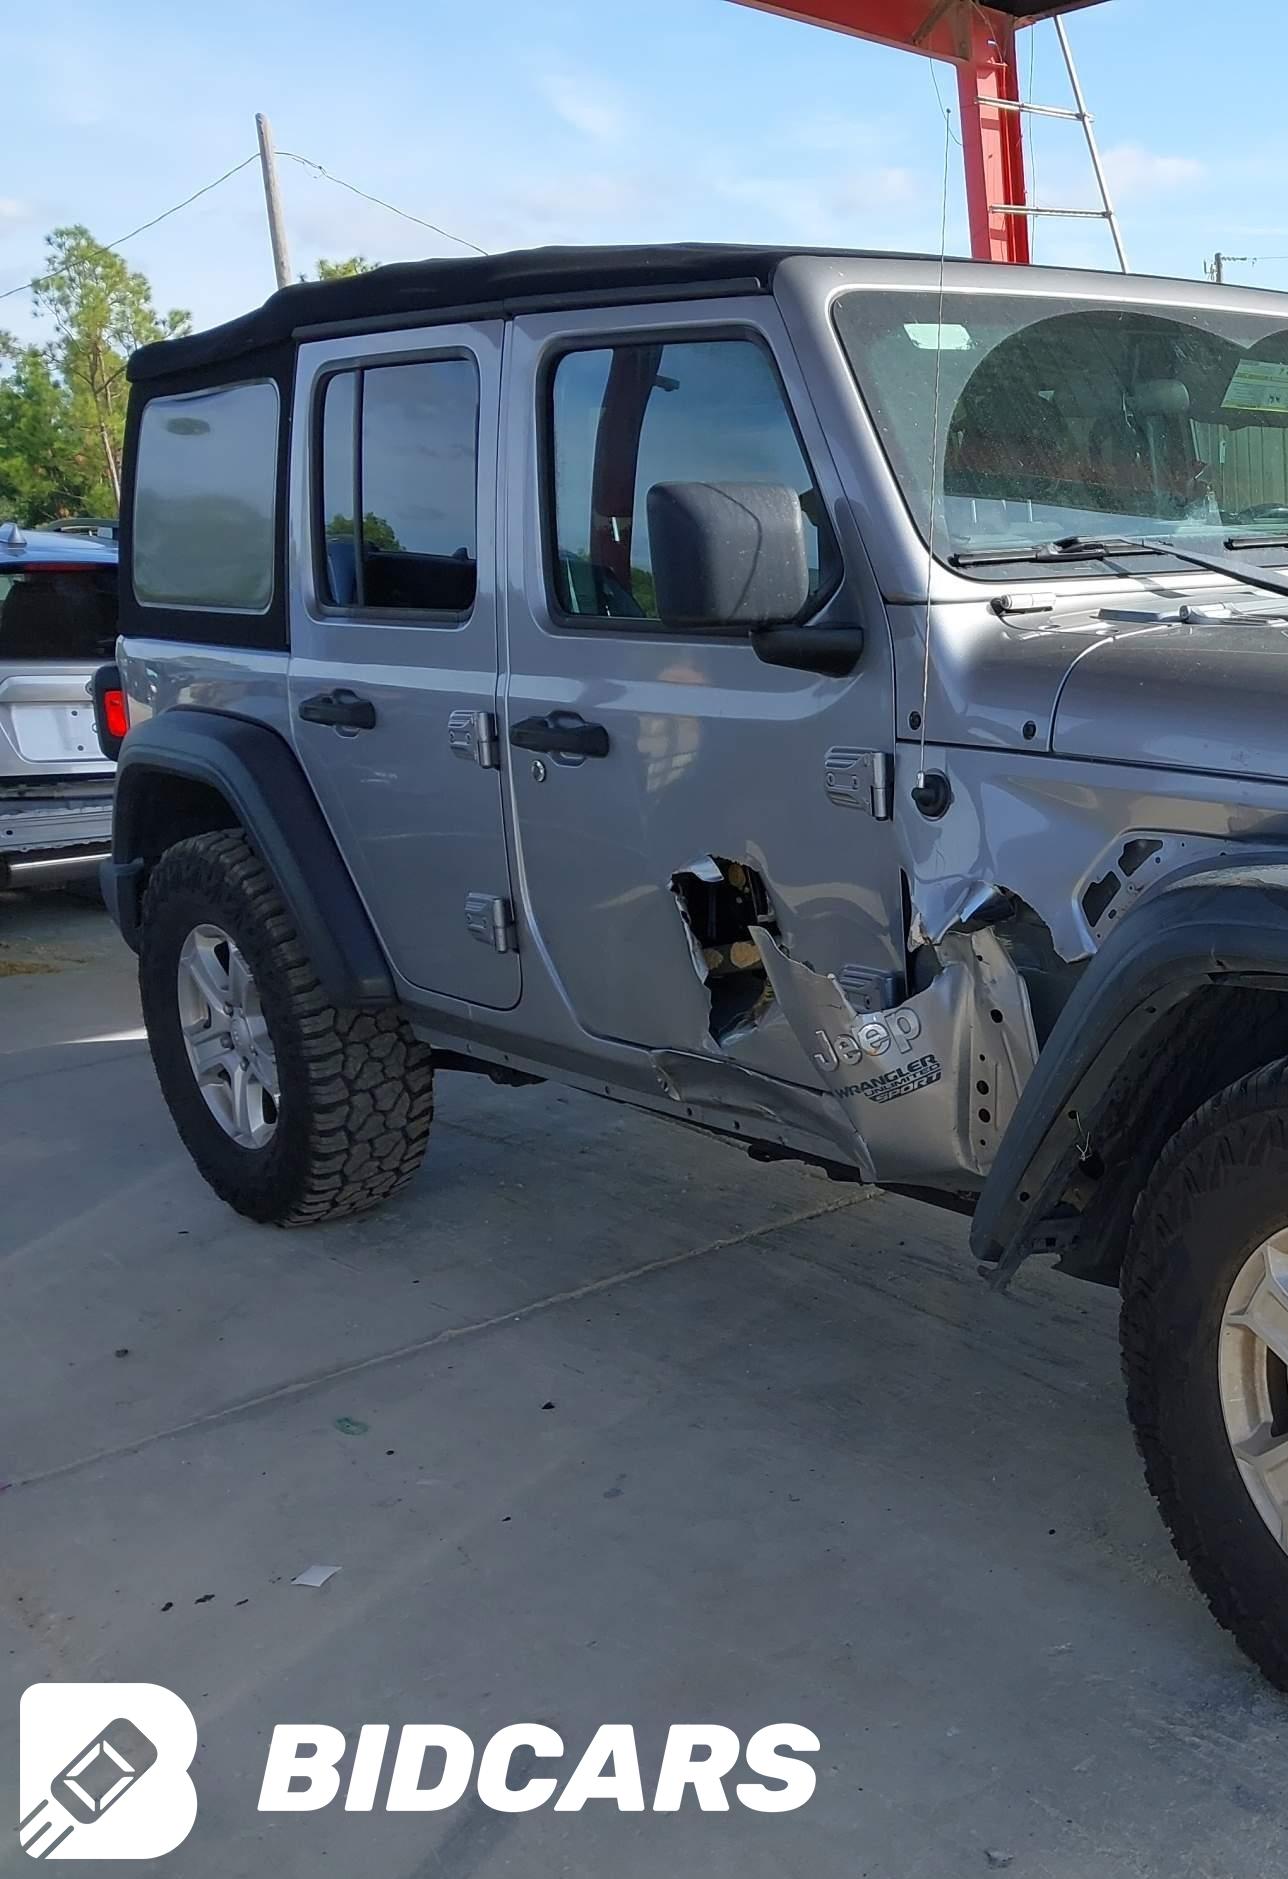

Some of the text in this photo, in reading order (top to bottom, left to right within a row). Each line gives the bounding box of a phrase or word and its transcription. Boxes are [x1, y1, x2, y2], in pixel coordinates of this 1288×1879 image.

[814, 1008, 920, 1072] Jeep
[836, 1054, 938, 1099] WRANGLER
[865, 1064, 942, 1096] UNLIMITED
[869, 1072, 942, 1103] SPORT
